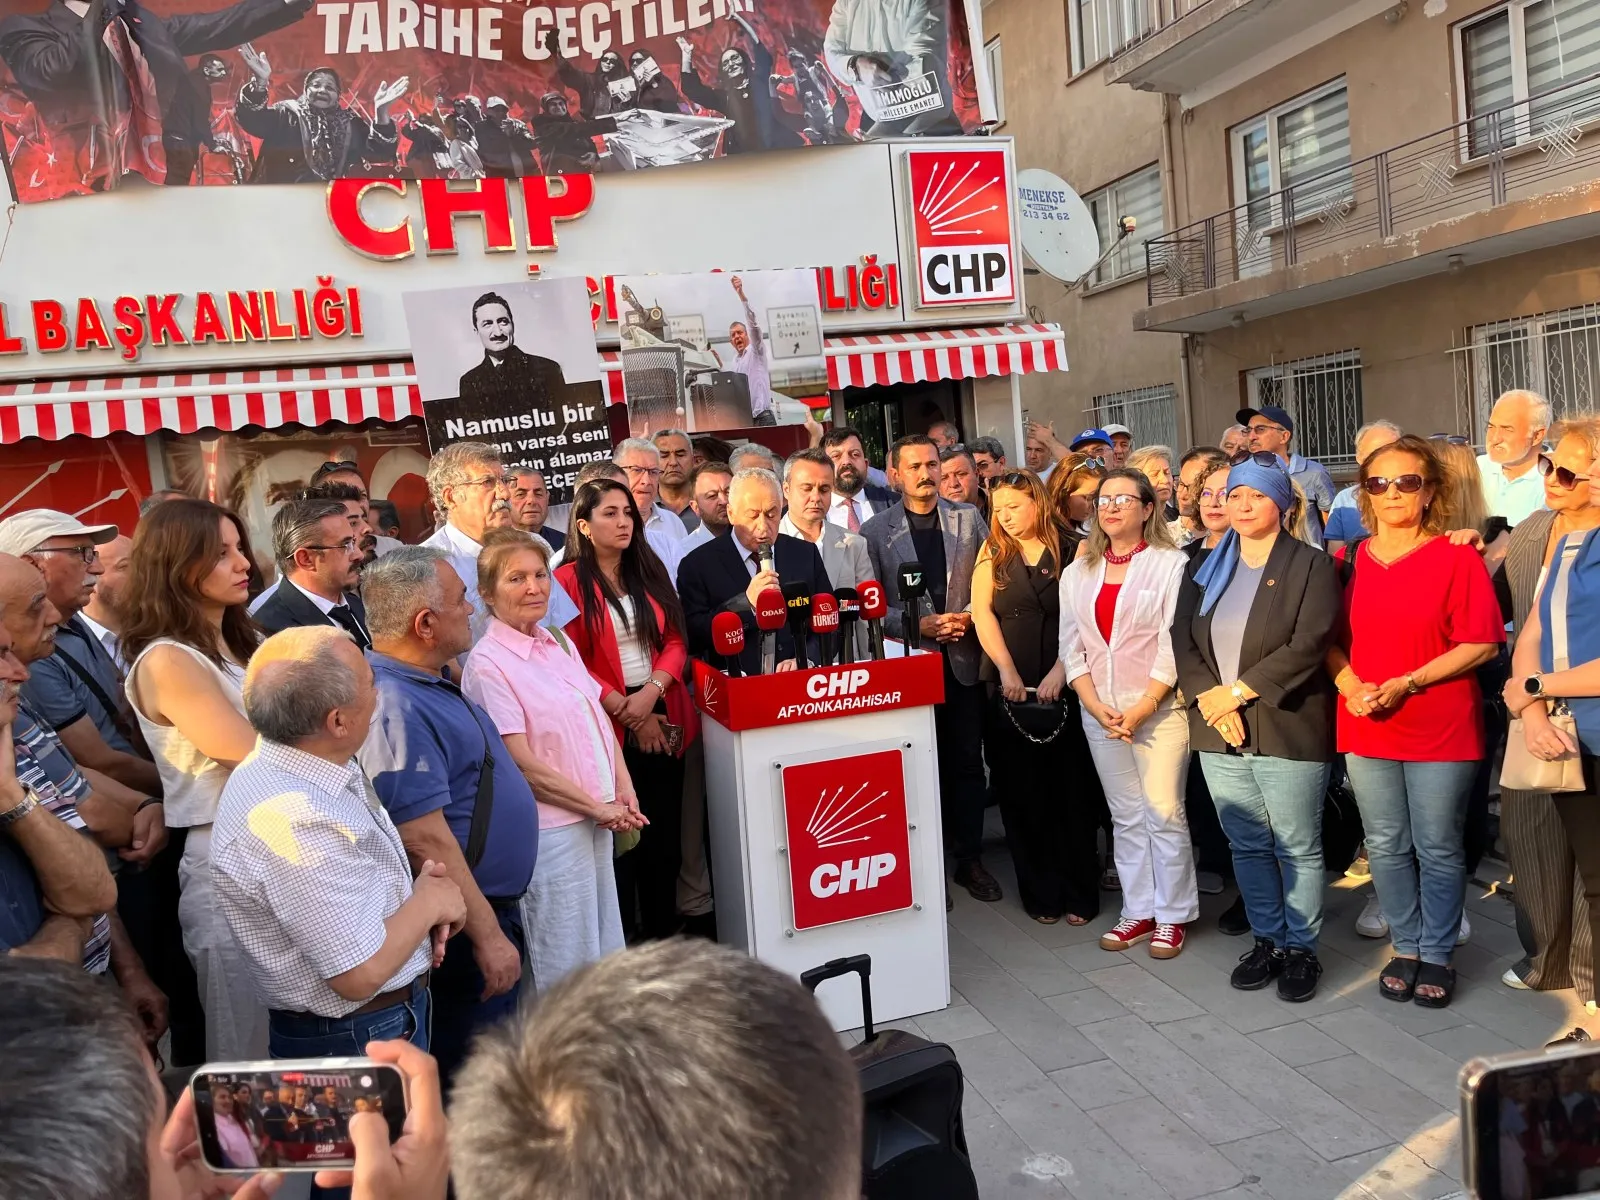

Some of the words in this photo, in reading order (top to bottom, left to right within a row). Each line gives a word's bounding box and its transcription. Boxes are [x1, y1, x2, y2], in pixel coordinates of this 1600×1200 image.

[910, 97, 935, 112] EMANET
[326, 174, 595, 262] CHP
[1041, 212, 1054, 220] 34
[1056, 212, 1070, 220] 62
[926, 252, 1006, 295] CHP
[31, 275, 364, 361] BAŞKANLIĞI
[445, 408, 556, 439] Namuslu
[562, 403, 595, 424] bir
[517, 433, 568, 451] varsa
[572, 426, 610, 443] seni
[549, 449, 613, 469] alamaz
[788, 596, 810, 608] GÜN
[864, 587, 880, 610] 3
[762, 608, 785, 617] ODAK
[806, 668, 870, 699] CHP
[809, 852, 897, 899] CHP
